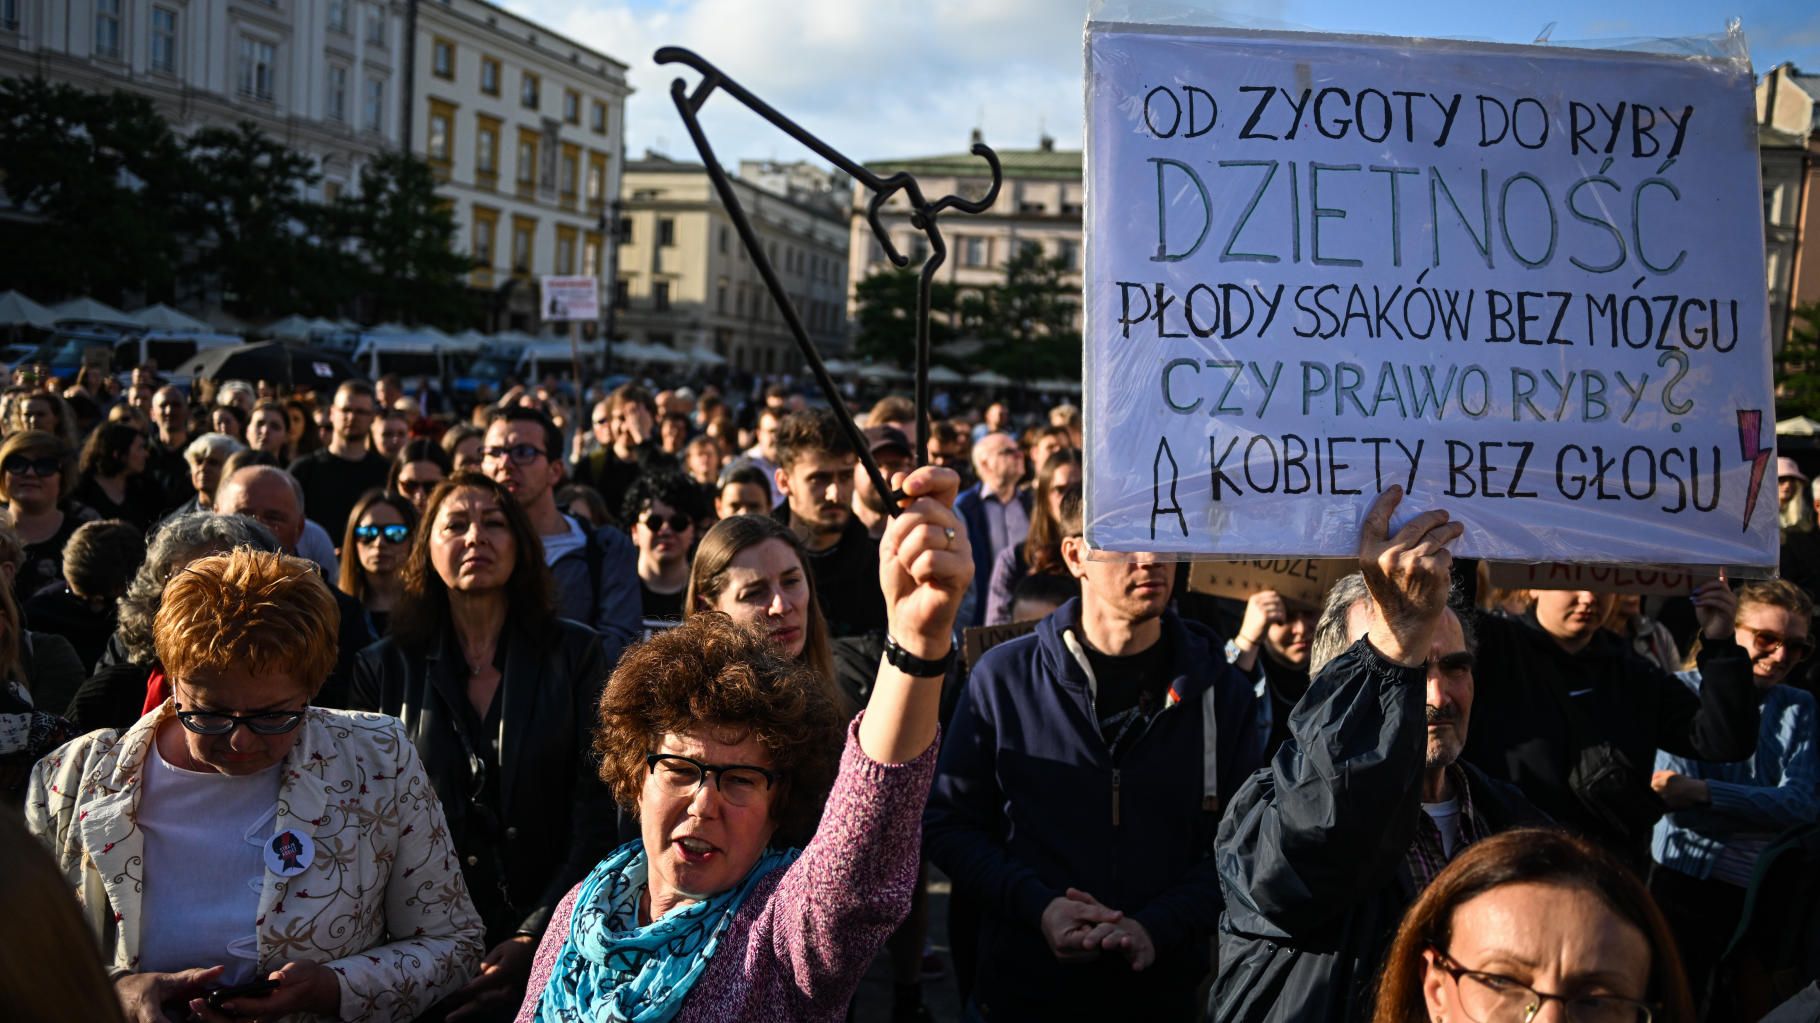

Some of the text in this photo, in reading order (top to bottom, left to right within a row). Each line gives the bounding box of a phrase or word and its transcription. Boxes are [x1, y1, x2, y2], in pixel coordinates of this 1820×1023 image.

[1144, 85, 1693, 159] OD ZYGOTY DO RYBY
[1147, 158, 1687, 275] DZIETNOŚĆ
[1116, 268, 1738, 353] PŁODY SSAKÓW BEZ MÓZGU
[1161, 350, 1694, 433] CZY PRAWO RYBY?
[1150, 434, 1721, 540] A KOBIETY BEZ GŁOSU
